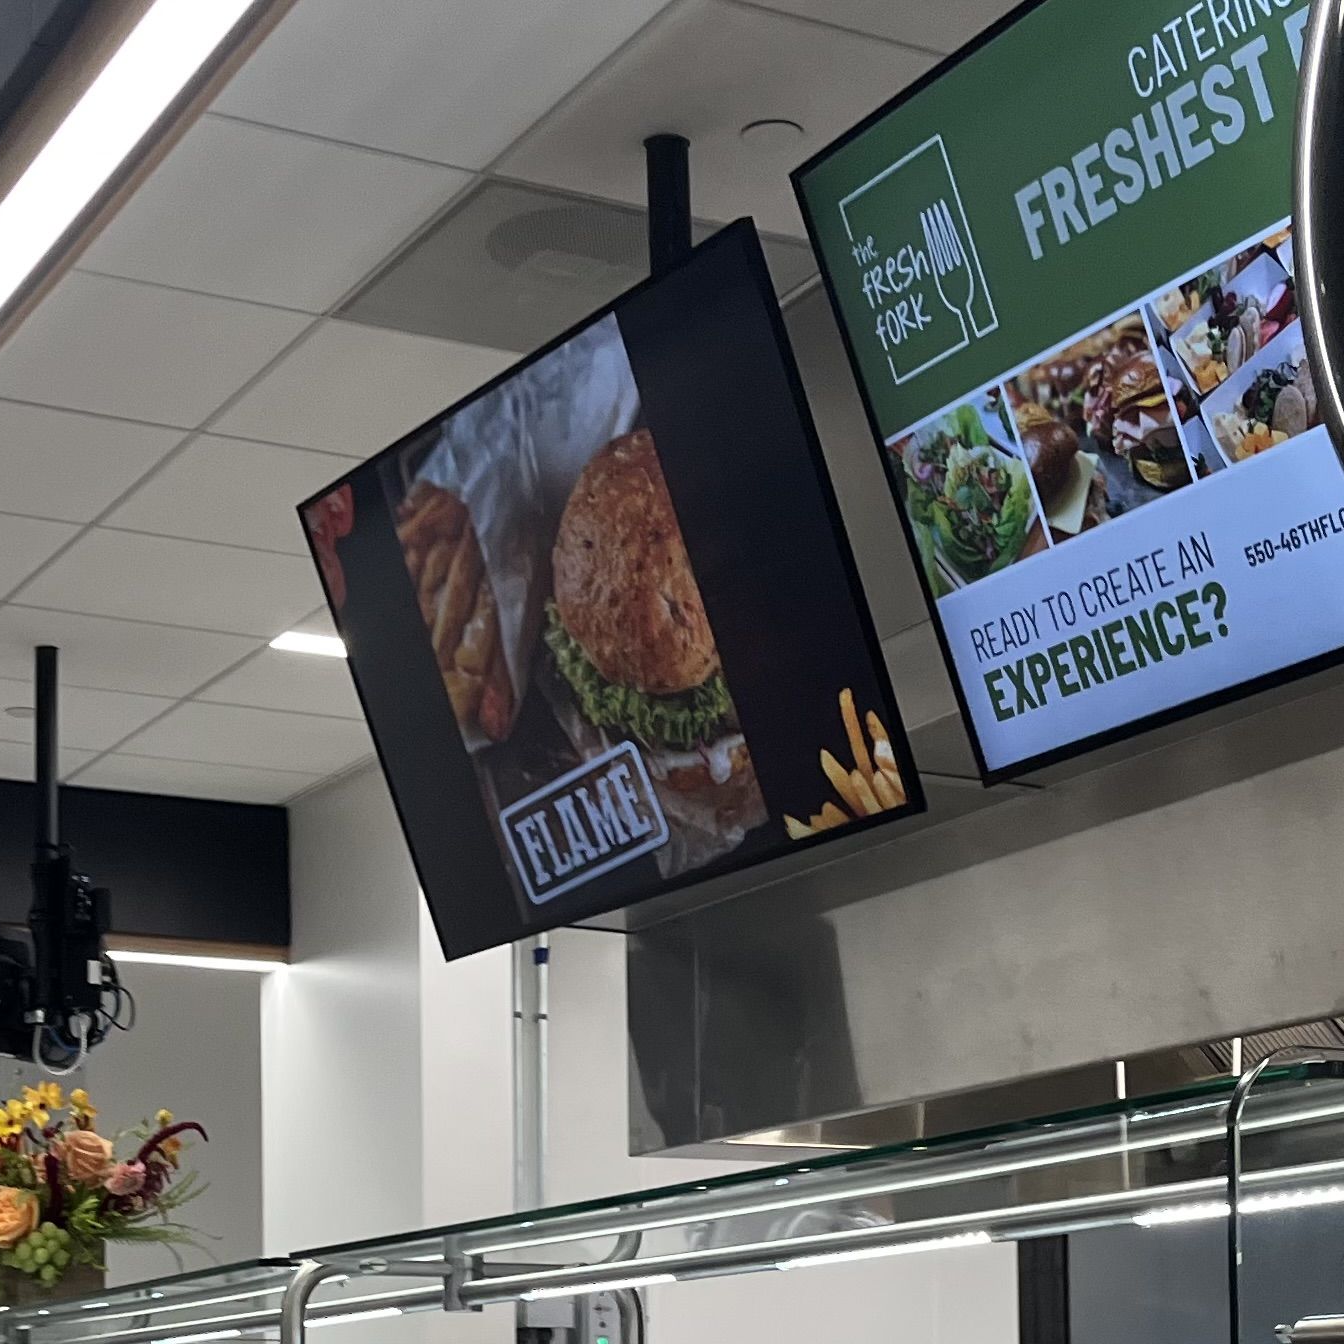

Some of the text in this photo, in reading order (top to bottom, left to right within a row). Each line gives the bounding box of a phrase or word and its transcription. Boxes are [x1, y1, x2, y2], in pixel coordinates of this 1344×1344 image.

[1128, 0, 1292, 97] CATERIN
[1014, 34, 1274, 260] FRESHEST
[970, 531, 1215, 663] READY TO CREATE AN
[983, 581, 1229, 722] EXPERIENCE?
[514, 763, 652, 886] FLAME
